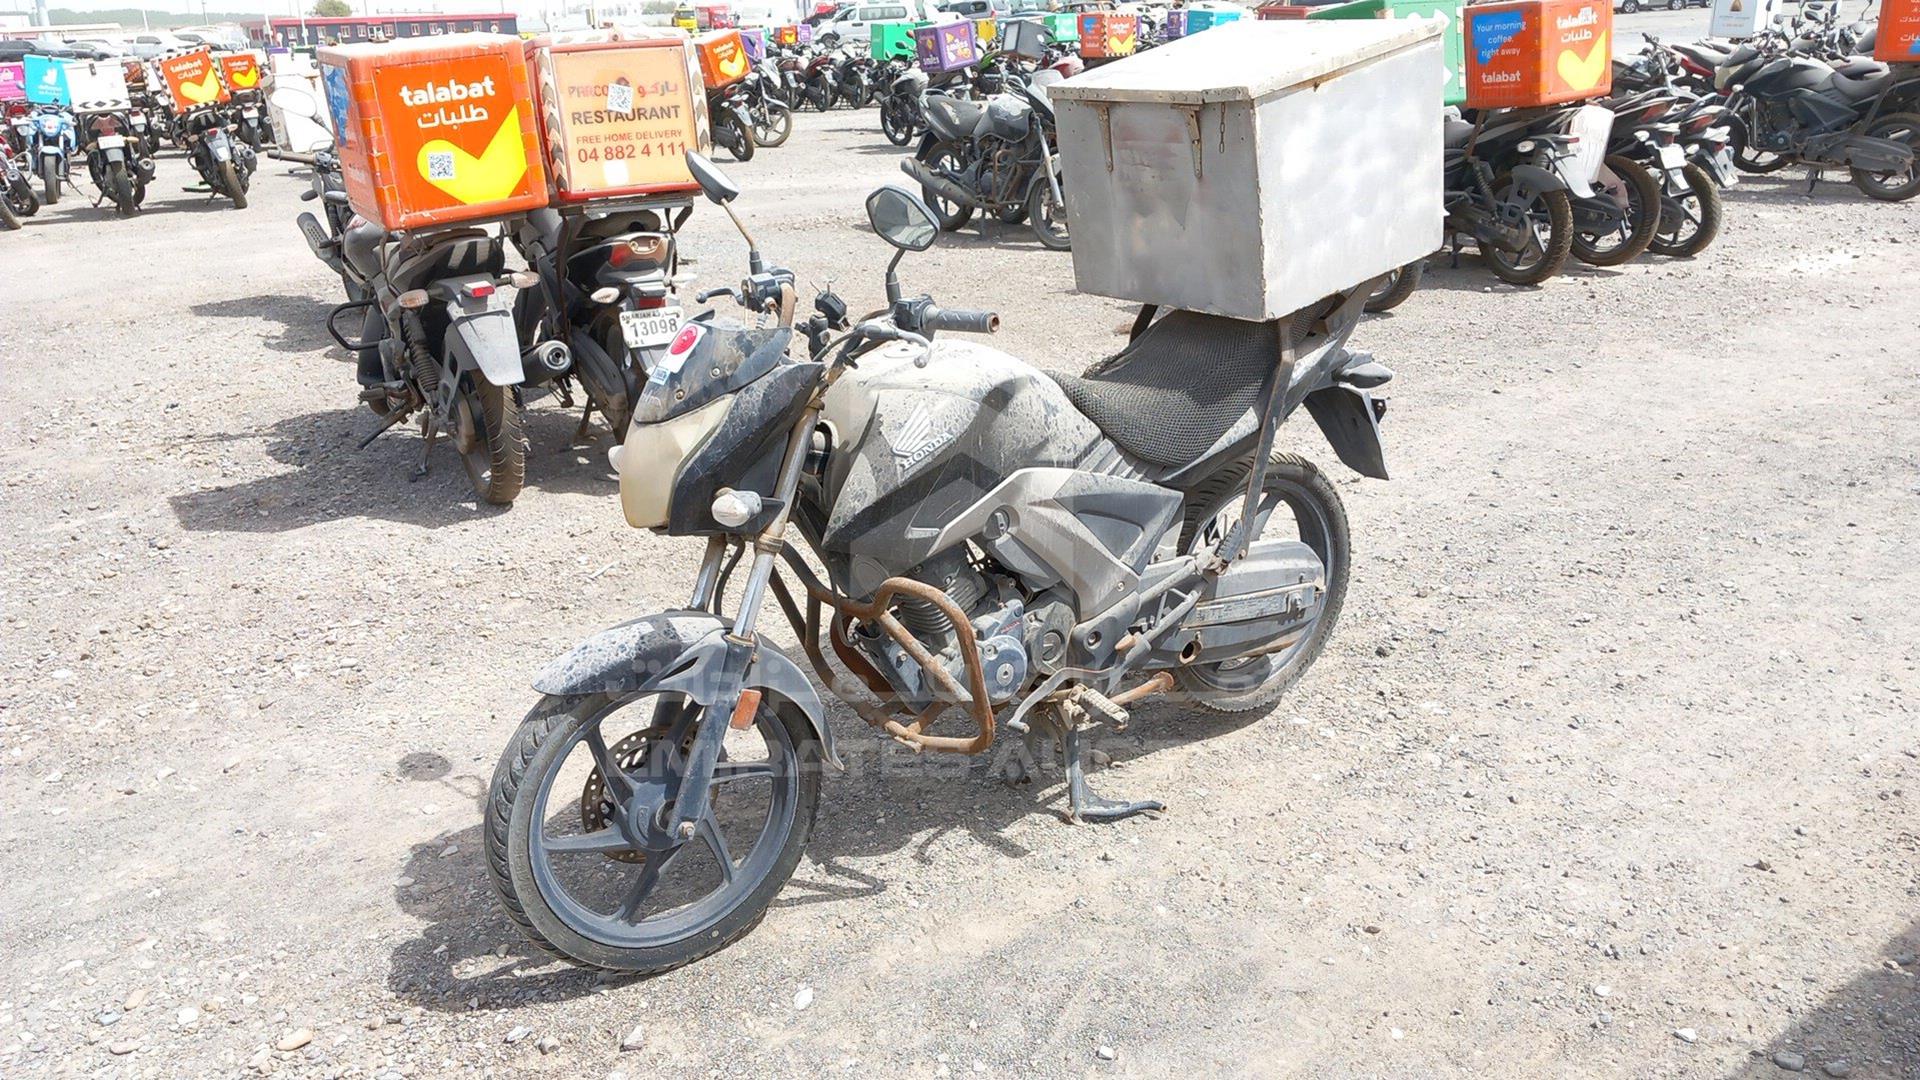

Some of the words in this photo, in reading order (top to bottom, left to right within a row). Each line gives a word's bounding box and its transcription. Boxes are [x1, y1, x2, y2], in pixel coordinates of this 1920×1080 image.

[1476, 24, 1493, 33] Your
[1494, 21, 1527, 31] morning
[1560, 28, 1593, 44] طلبات
[1481, 47, 1500, 59] right
[1500, 48, 1521, 56] away
[1481, 70, 1521, 84] talabat
[399, 75, 496, 107] talabat
[416, 104, 489, 130] طلبات
[571, 105, 681, 125] RESTAURANT
[576, 135, 601, 144] FREE
[604, 131, 633, 143] HOME
[635, 129, 682, 141] DELIVERY
[577, 147, 599, 163] 04
[604, 144, 636, 161] 882
[641, 143, 651, 157] 4
[656, 141, 687, 156] 111
[630, 317, 678, 338] 13098
[902, 433, 954, 469] HONDA
